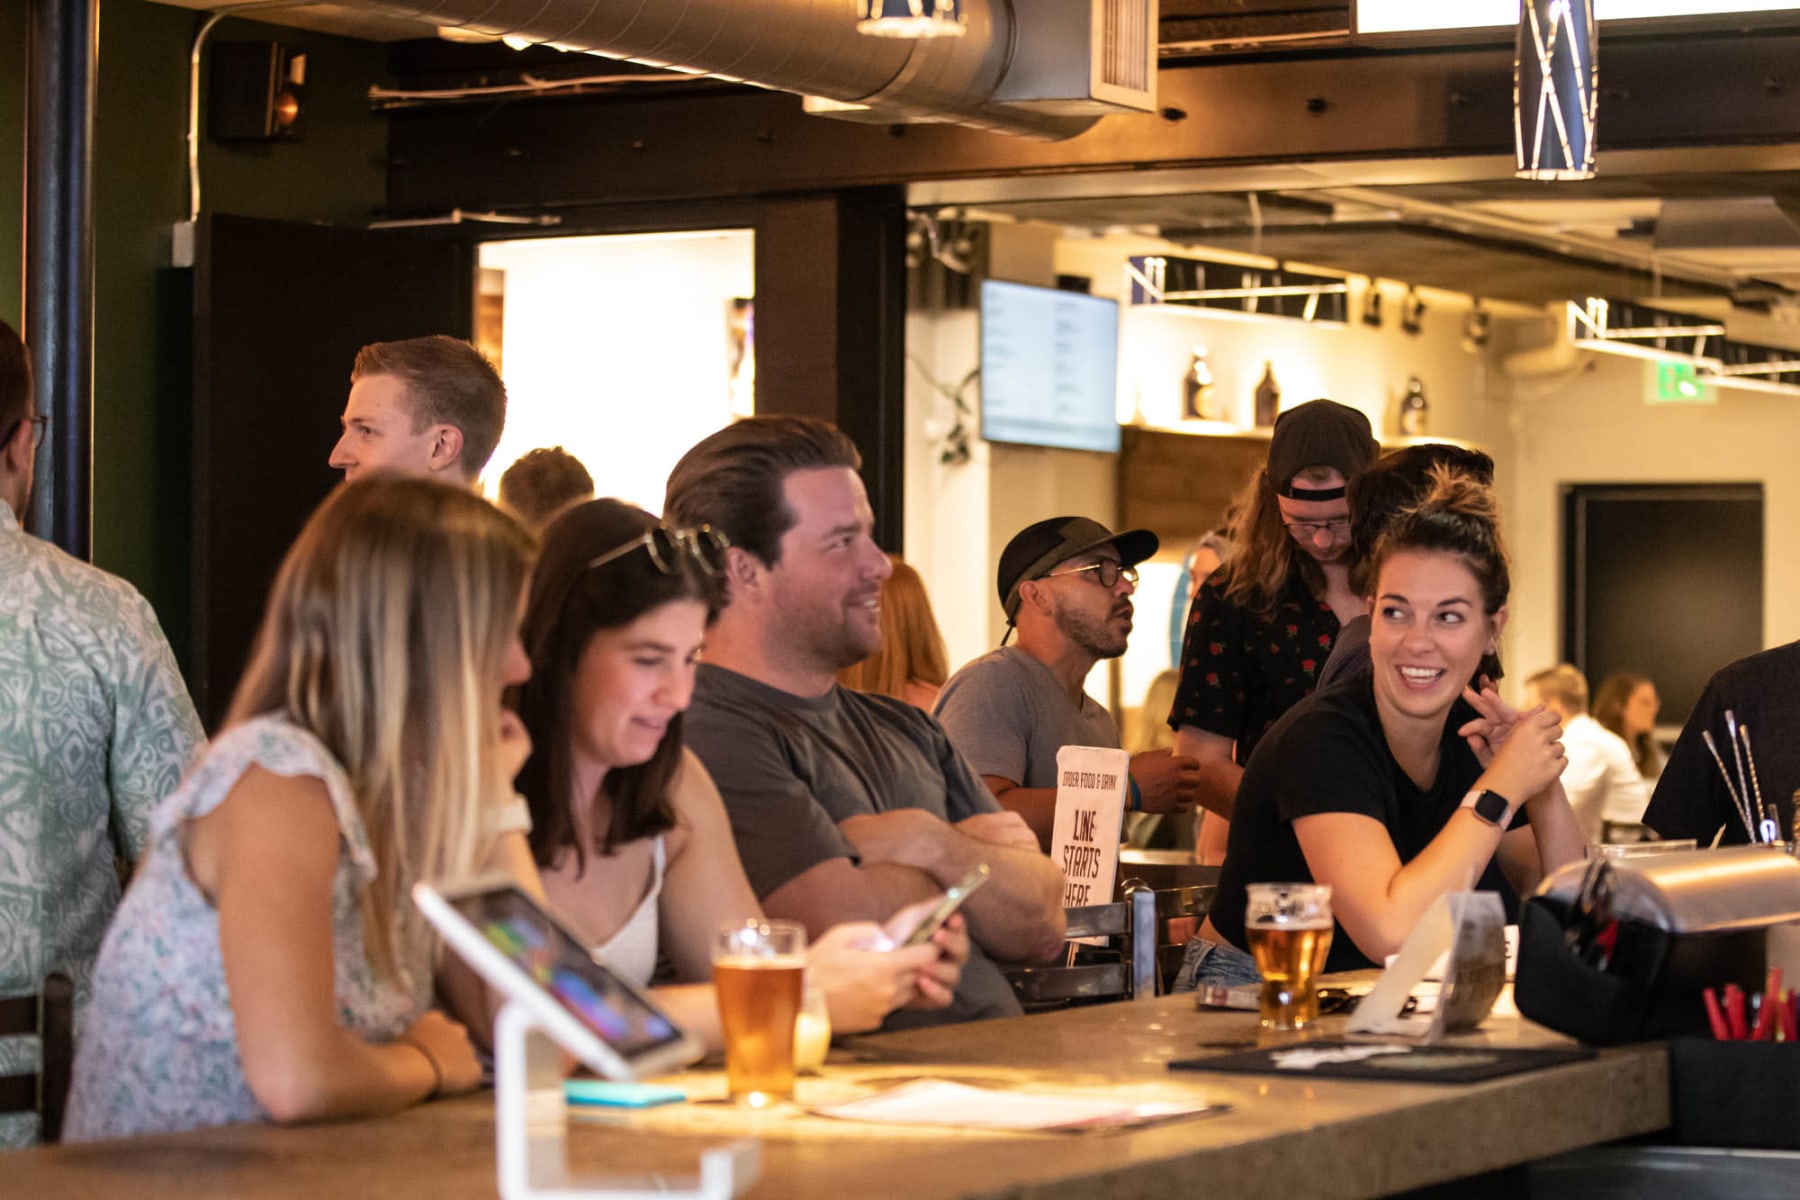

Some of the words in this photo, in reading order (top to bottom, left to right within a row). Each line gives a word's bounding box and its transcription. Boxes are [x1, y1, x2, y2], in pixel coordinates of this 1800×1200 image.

[1062, 771, 1079, 787] ORDER
[1080, 772, 1095, 789] FOOD
[1101, 774, 1118, 790] DRINK
[1073, 809, 1096, 842] LINE
[1062, 845, 1101, 879] STARTS
